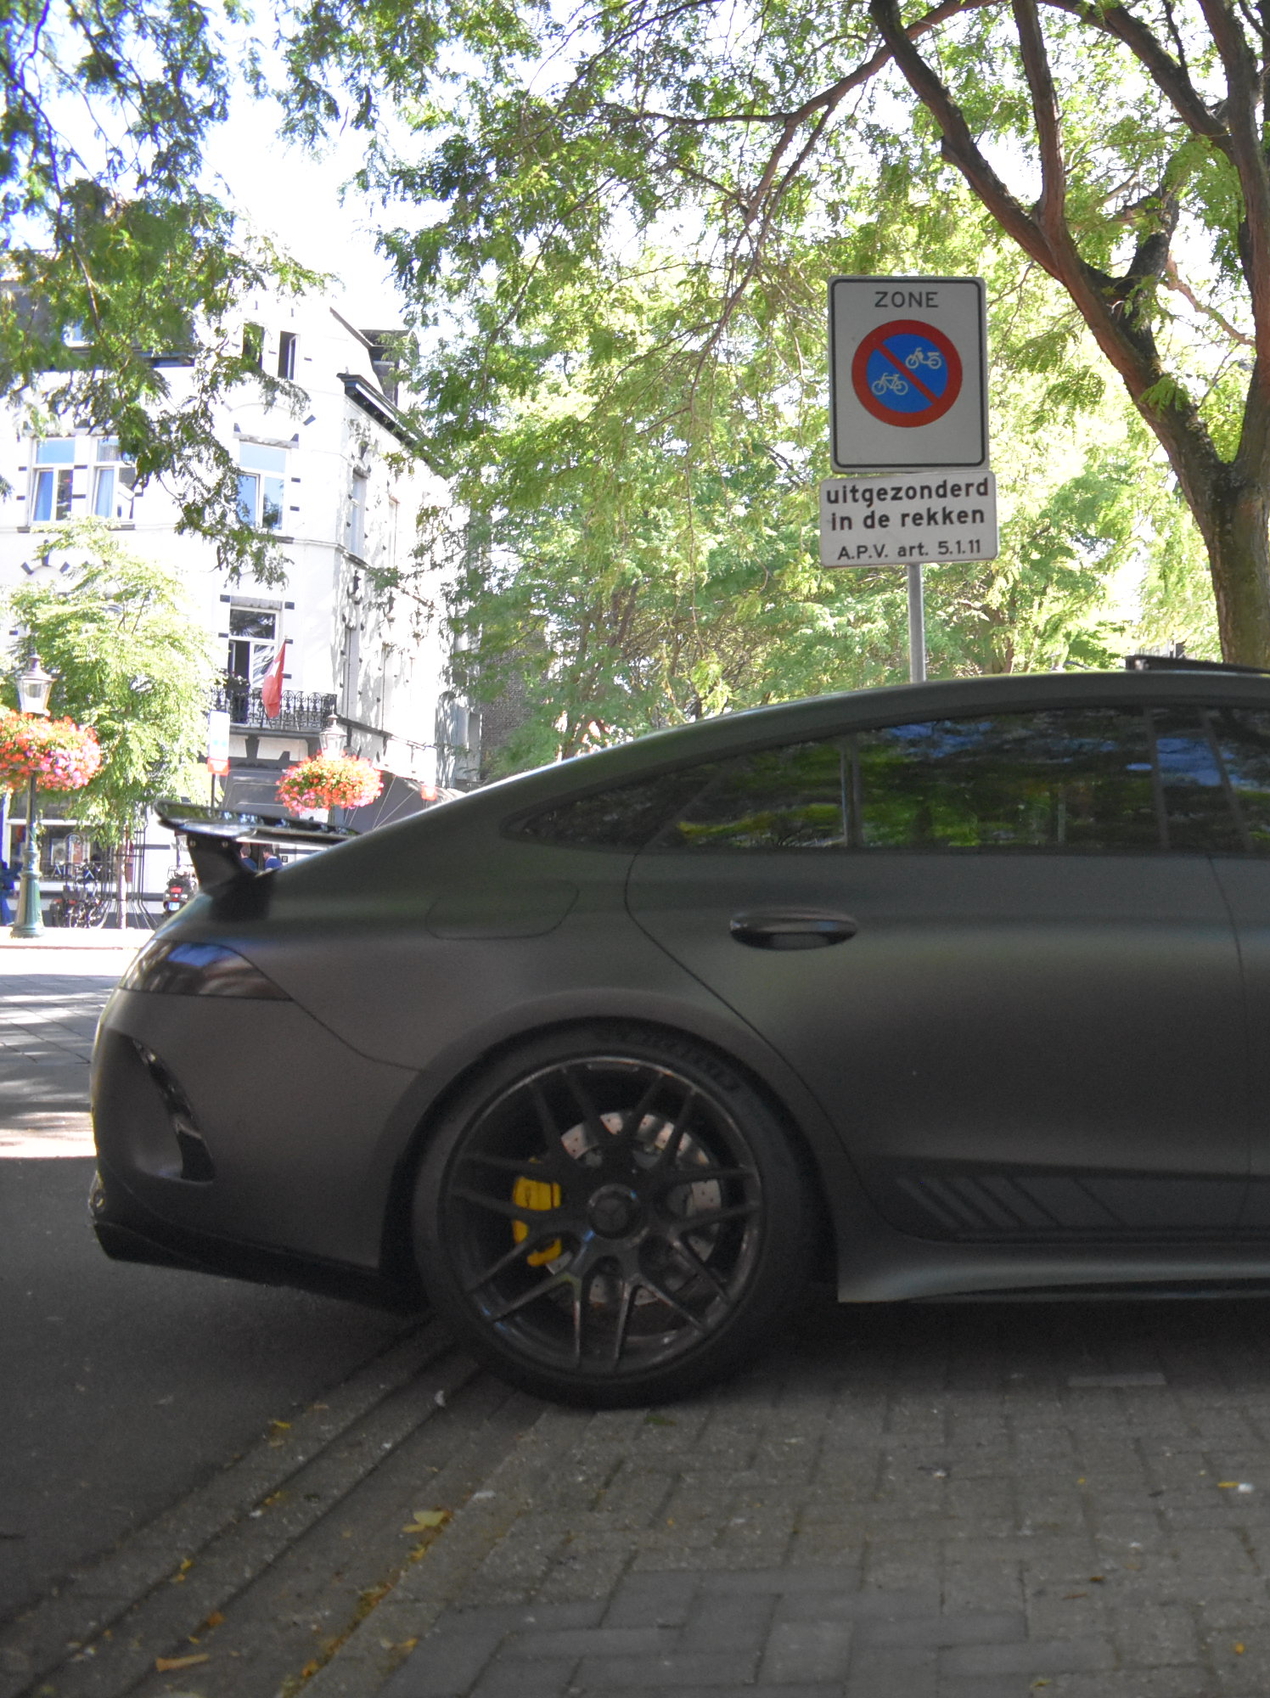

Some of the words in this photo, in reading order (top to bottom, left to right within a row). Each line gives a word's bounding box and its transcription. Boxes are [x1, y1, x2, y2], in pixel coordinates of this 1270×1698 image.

[875, 291, 939, 308] ZONE
[826, 477, 989, 508] uitgezonderd
[831, 512, 852, 531] in
[863, 510, 890, 529] de
[901, 507, 985, 527] rekken
[837, 544, 888, 560] A.P.V.
[897, 542, 929, 557] art.
[938, 539, 981, 555] 5.1.11
